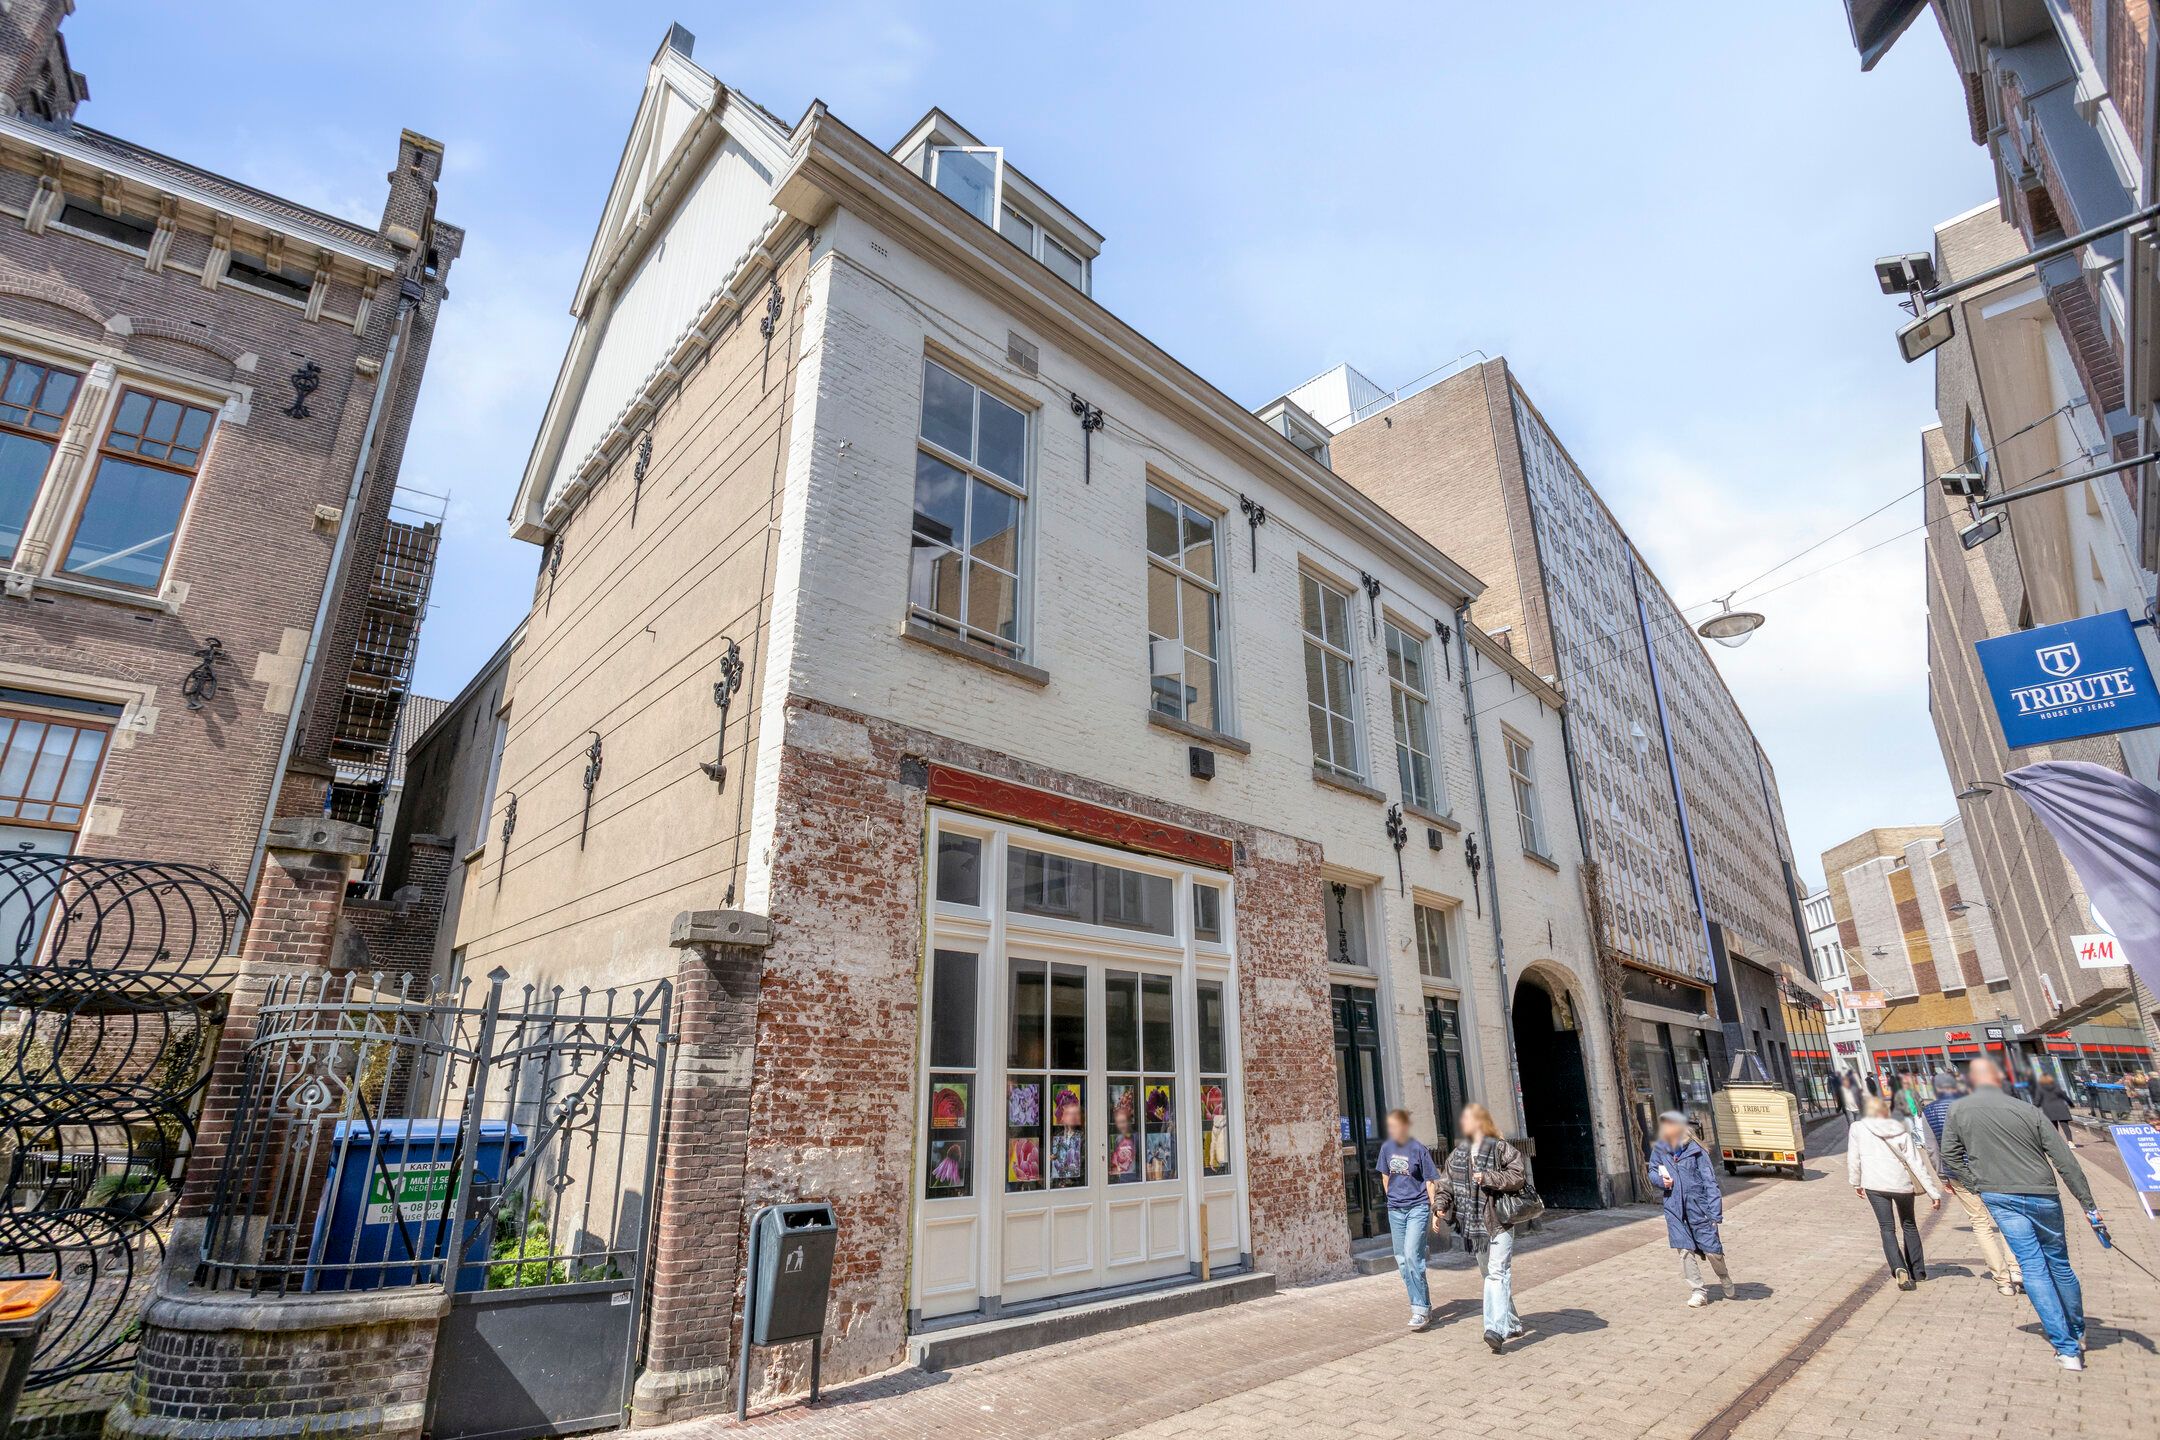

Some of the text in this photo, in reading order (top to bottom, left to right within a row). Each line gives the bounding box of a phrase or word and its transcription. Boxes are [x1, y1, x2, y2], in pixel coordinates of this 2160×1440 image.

[2011, 670, 2135, 713] TRIBUTE
[2040, 701, 2116, 720] HOUSE OF JEANS
[2080, 941, 2114, 961] H&M
[1743, 1105, 1770, 1113] TRIBUTE
[2116, 1127, 2142, 1135] JINBO
